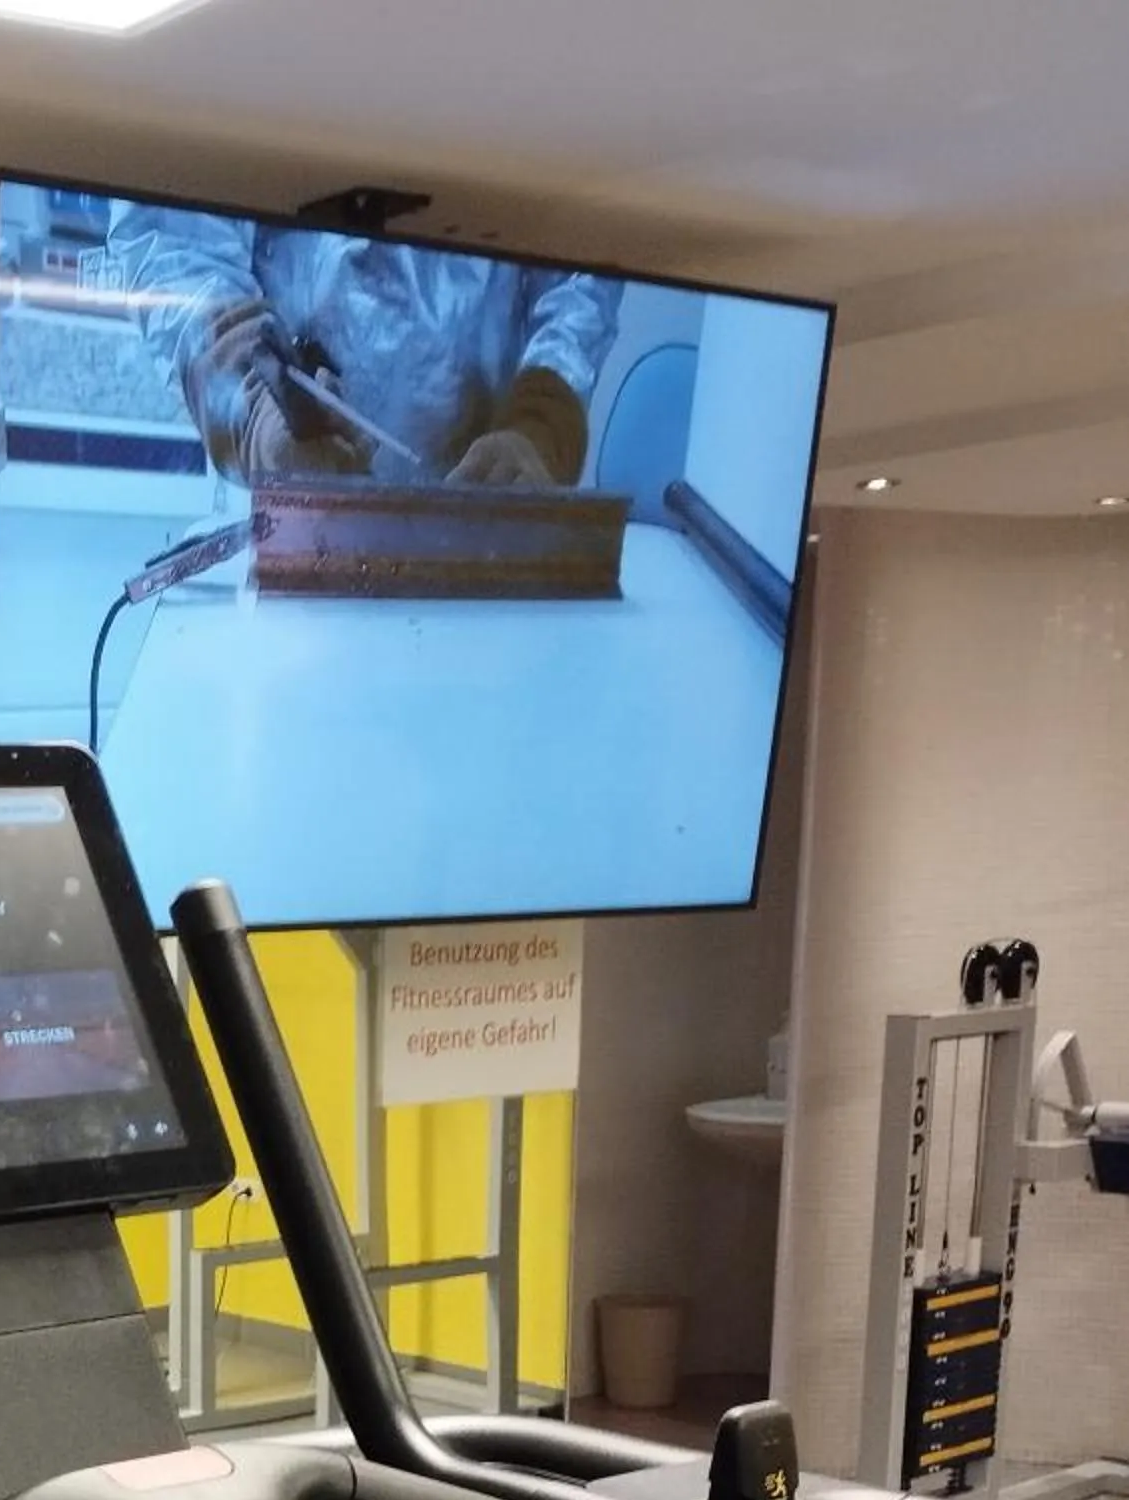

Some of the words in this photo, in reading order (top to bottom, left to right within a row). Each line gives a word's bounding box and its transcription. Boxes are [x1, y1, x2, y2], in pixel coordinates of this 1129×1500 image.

[409, 940, 521, 967] Benutzung
[524, 934, 559, 959] des
[391, 979, 539, 1011] Fitnessraumes
[542, 972, 577, 1001] auf
[3, 1026, 76, 1045] STRECKEN
[406, 1027, 476, 1057] eigene
[481, 1015, 557, 1047] Gefahr!
[912, 1077, 928, 1155] TOP
[904, 1174, 920, 1278] LINE
